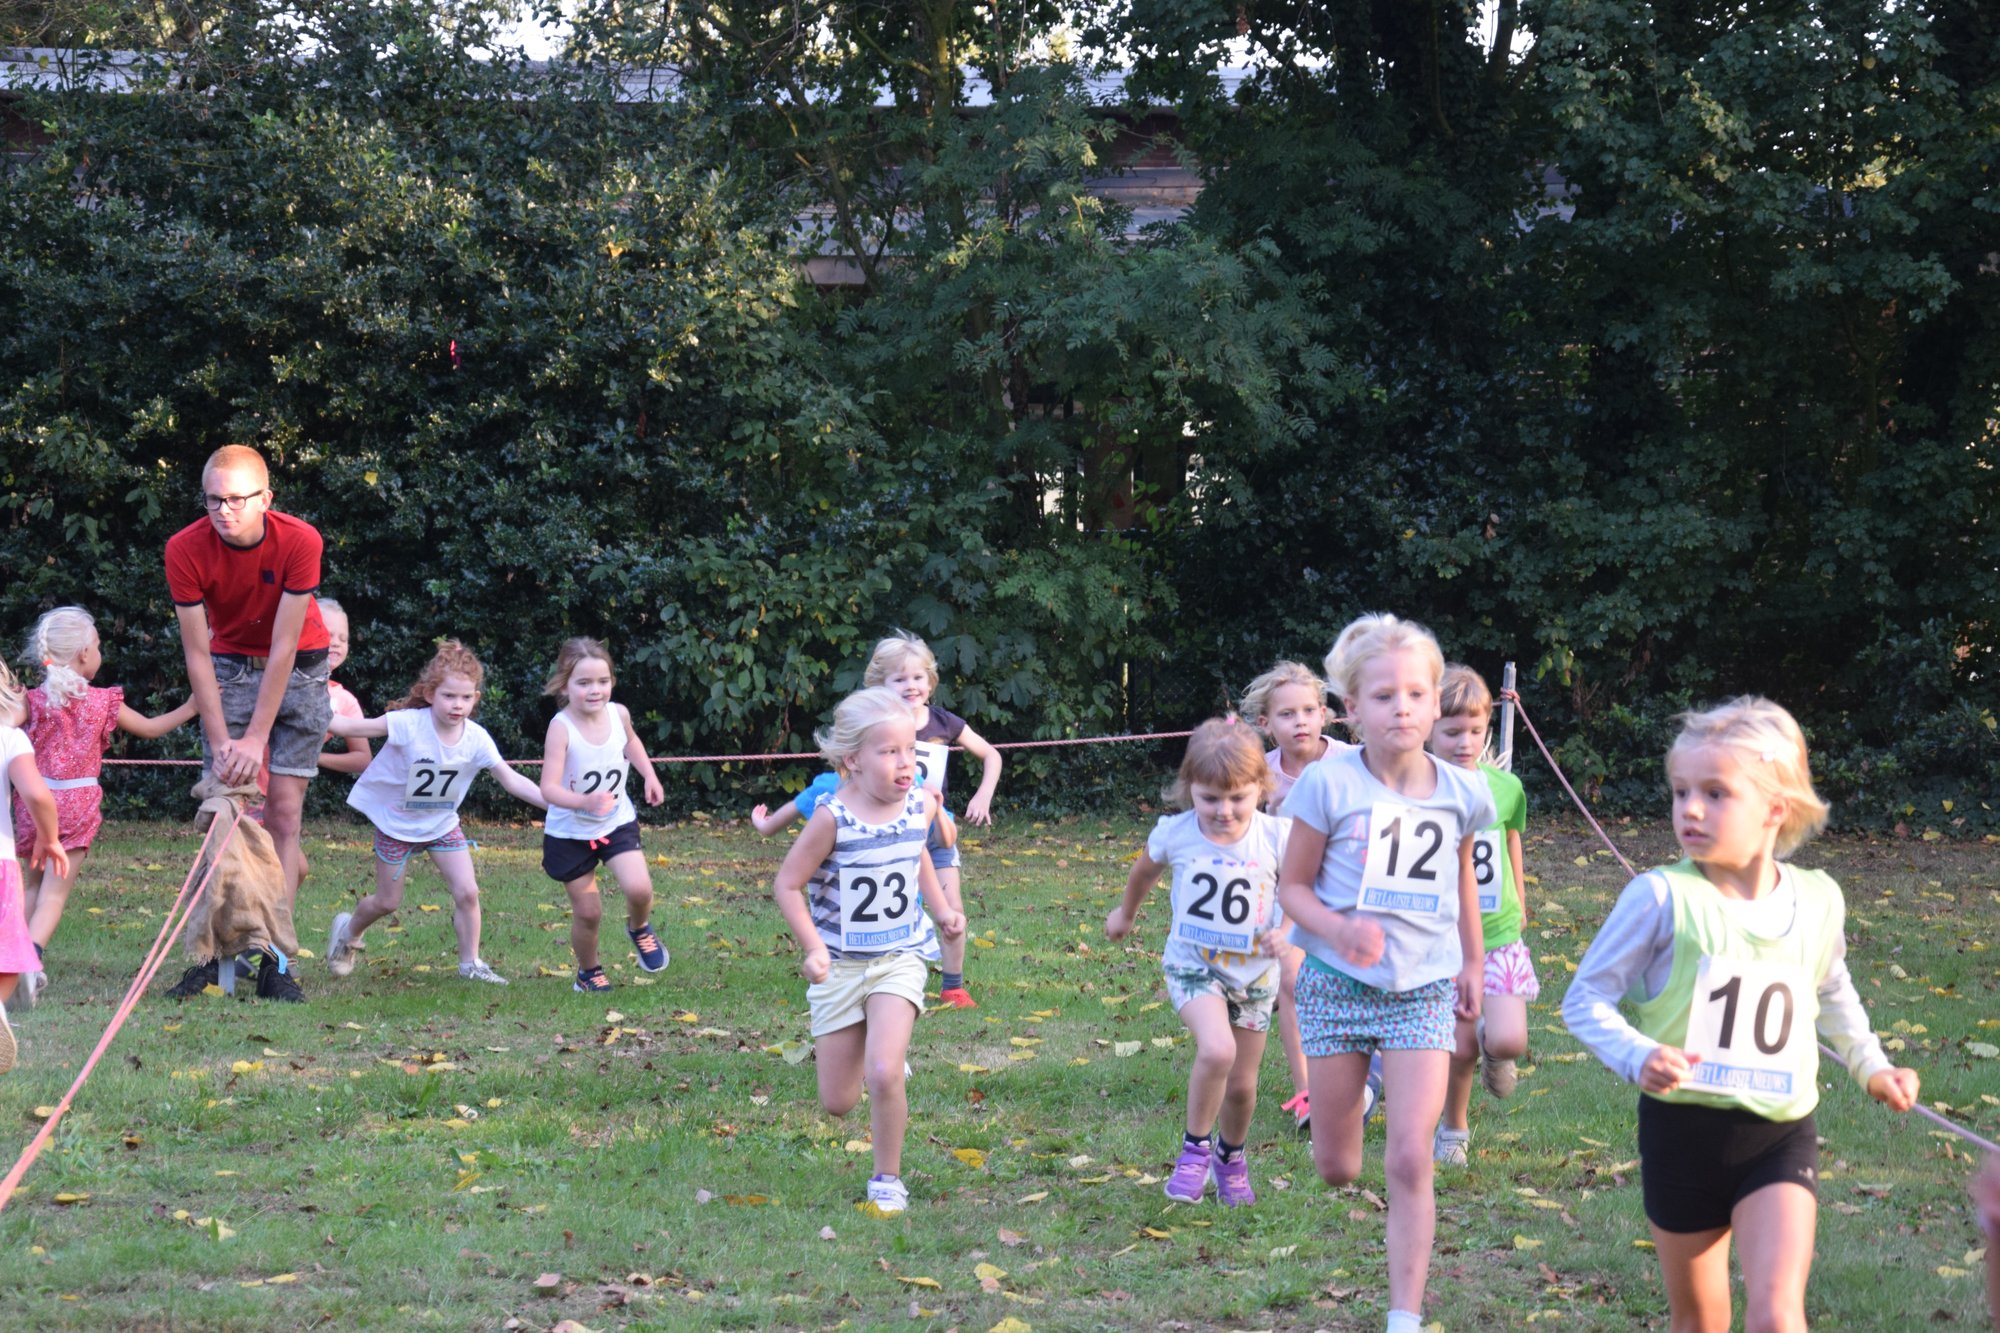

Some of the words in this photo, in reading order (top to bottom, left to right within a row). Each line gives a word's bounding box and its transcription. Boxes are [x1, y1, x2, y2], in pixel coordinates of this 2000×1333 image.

[412, 769, 459, 797] 27
[583, 769, 622, 800] 22
[1380, 816, 1443, 881] 12
[850, 872, 908, 922] 23
[1187, 872, 1251, 925] 26
[1709, 975, 1793, 1055] 10
